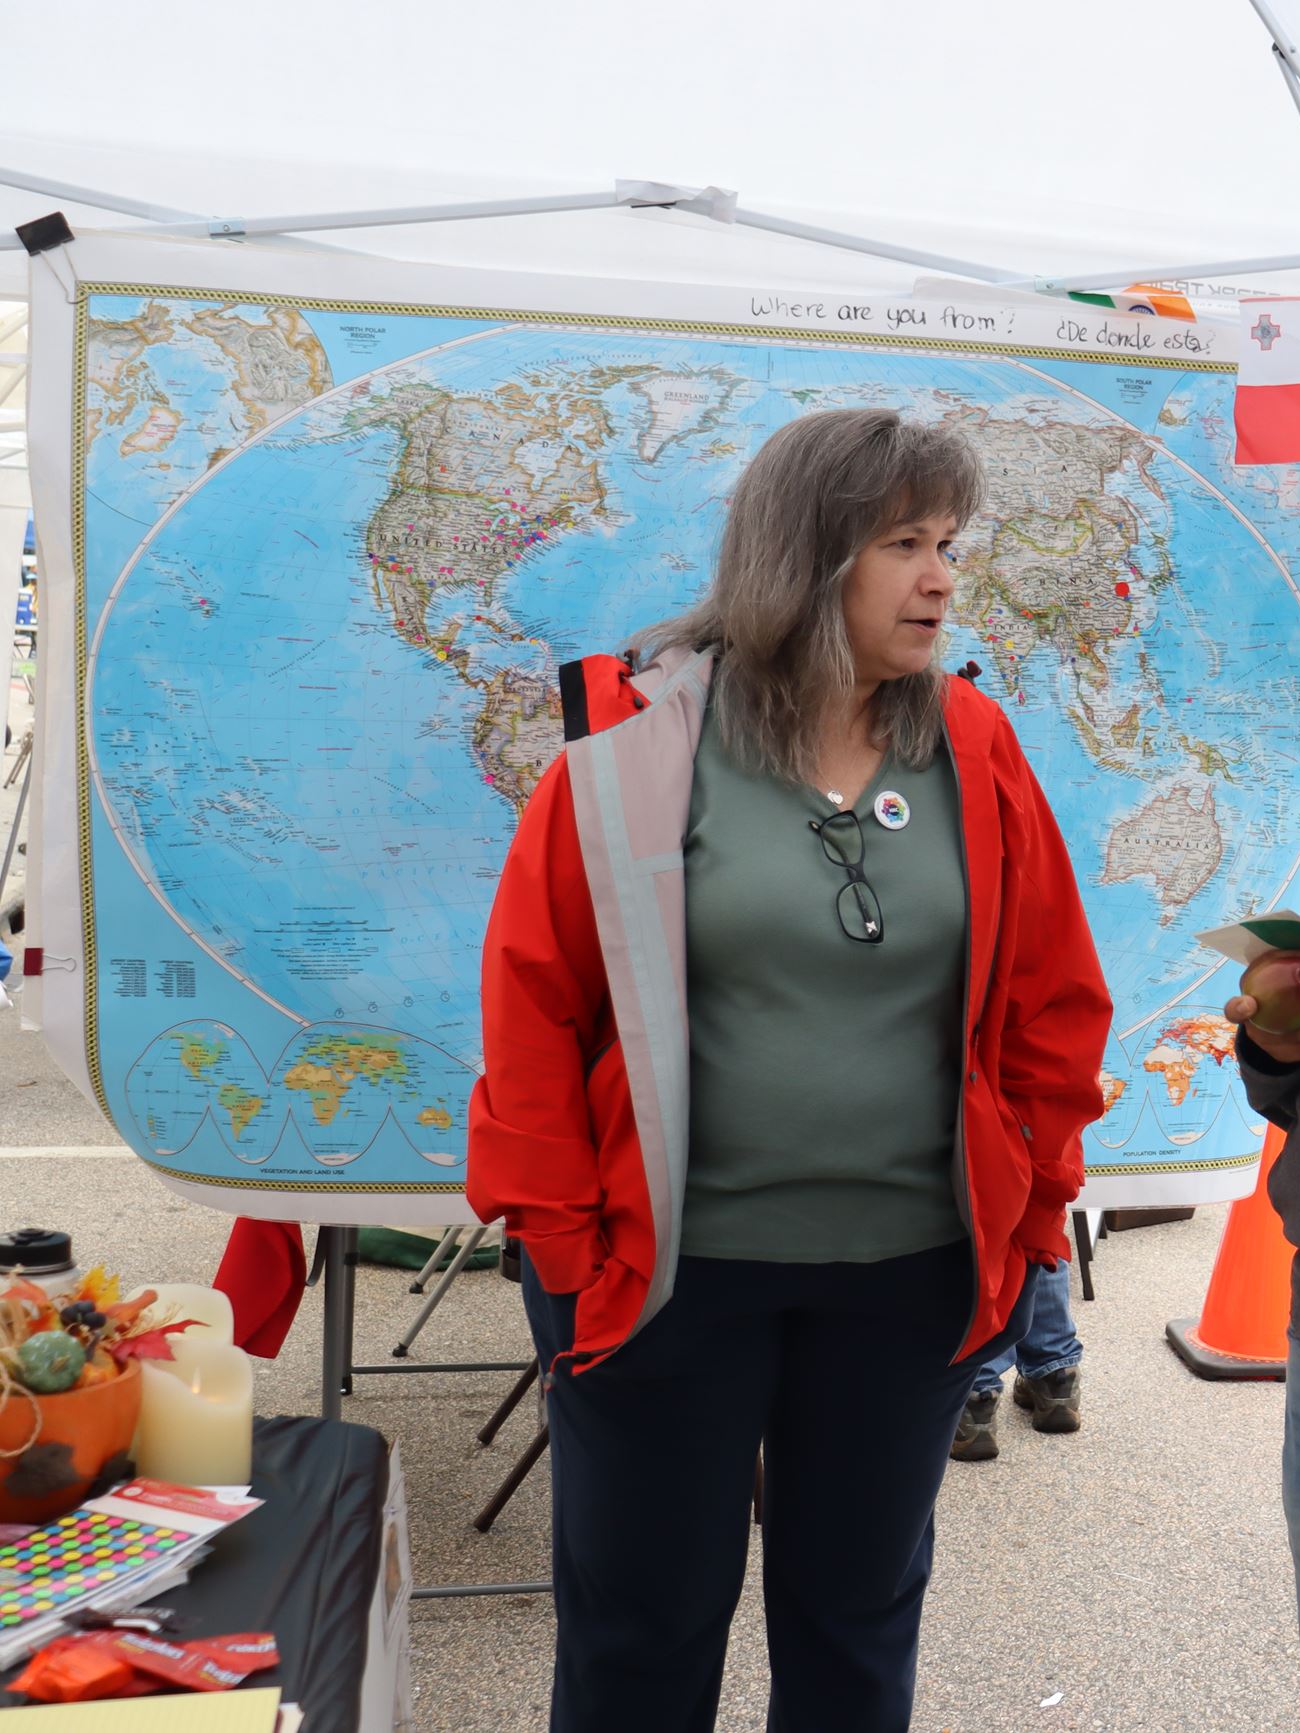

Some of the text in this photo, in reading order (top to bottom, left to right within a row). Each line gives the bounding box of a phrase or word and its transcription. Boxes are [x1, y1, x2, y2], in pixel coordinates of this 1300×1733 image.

[751, 296, 826, 319] Where
[838, 304, 874, 321] are
[887, 308, 927, 331] you
[664, 391, 709, 400] GREENLAND
[380, 534, 508, 554] UNITED STATES
[1024, 577, 1094, 585] CHINA
[1123, 837, 1209, 849] AUSTRALIA
